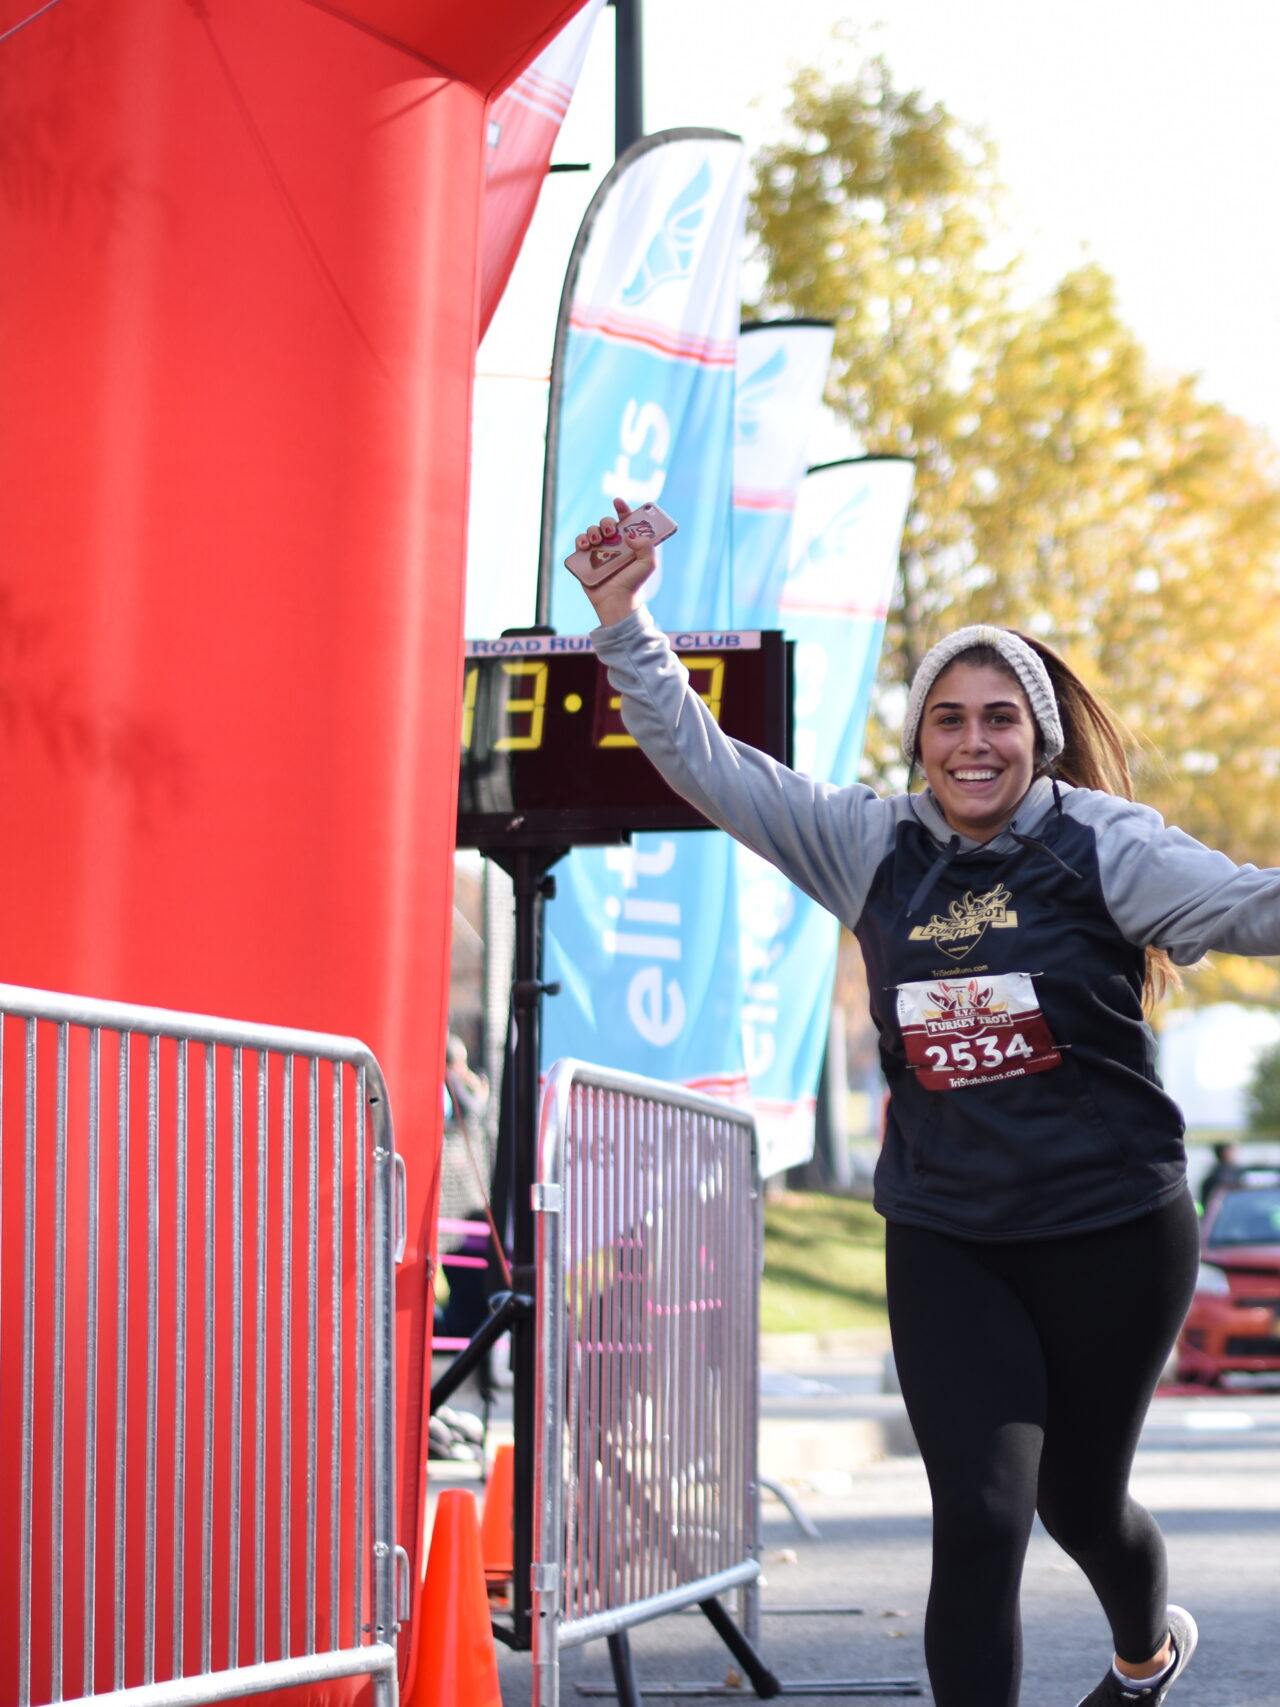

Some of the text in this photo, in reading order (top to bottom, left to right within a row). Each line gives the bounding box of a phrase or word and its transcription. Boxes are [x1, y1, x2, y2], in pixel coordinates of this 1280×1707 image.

[472, 639, 542, 655] ROAD
[675, 634, 741, 649] CLUB
[928, 1013, 1008, 1032] TURKEY TROT
[925, 1033, 1034, 1072] 2534
[948, 1067, 1026, 1088] TriStateRuns.com
